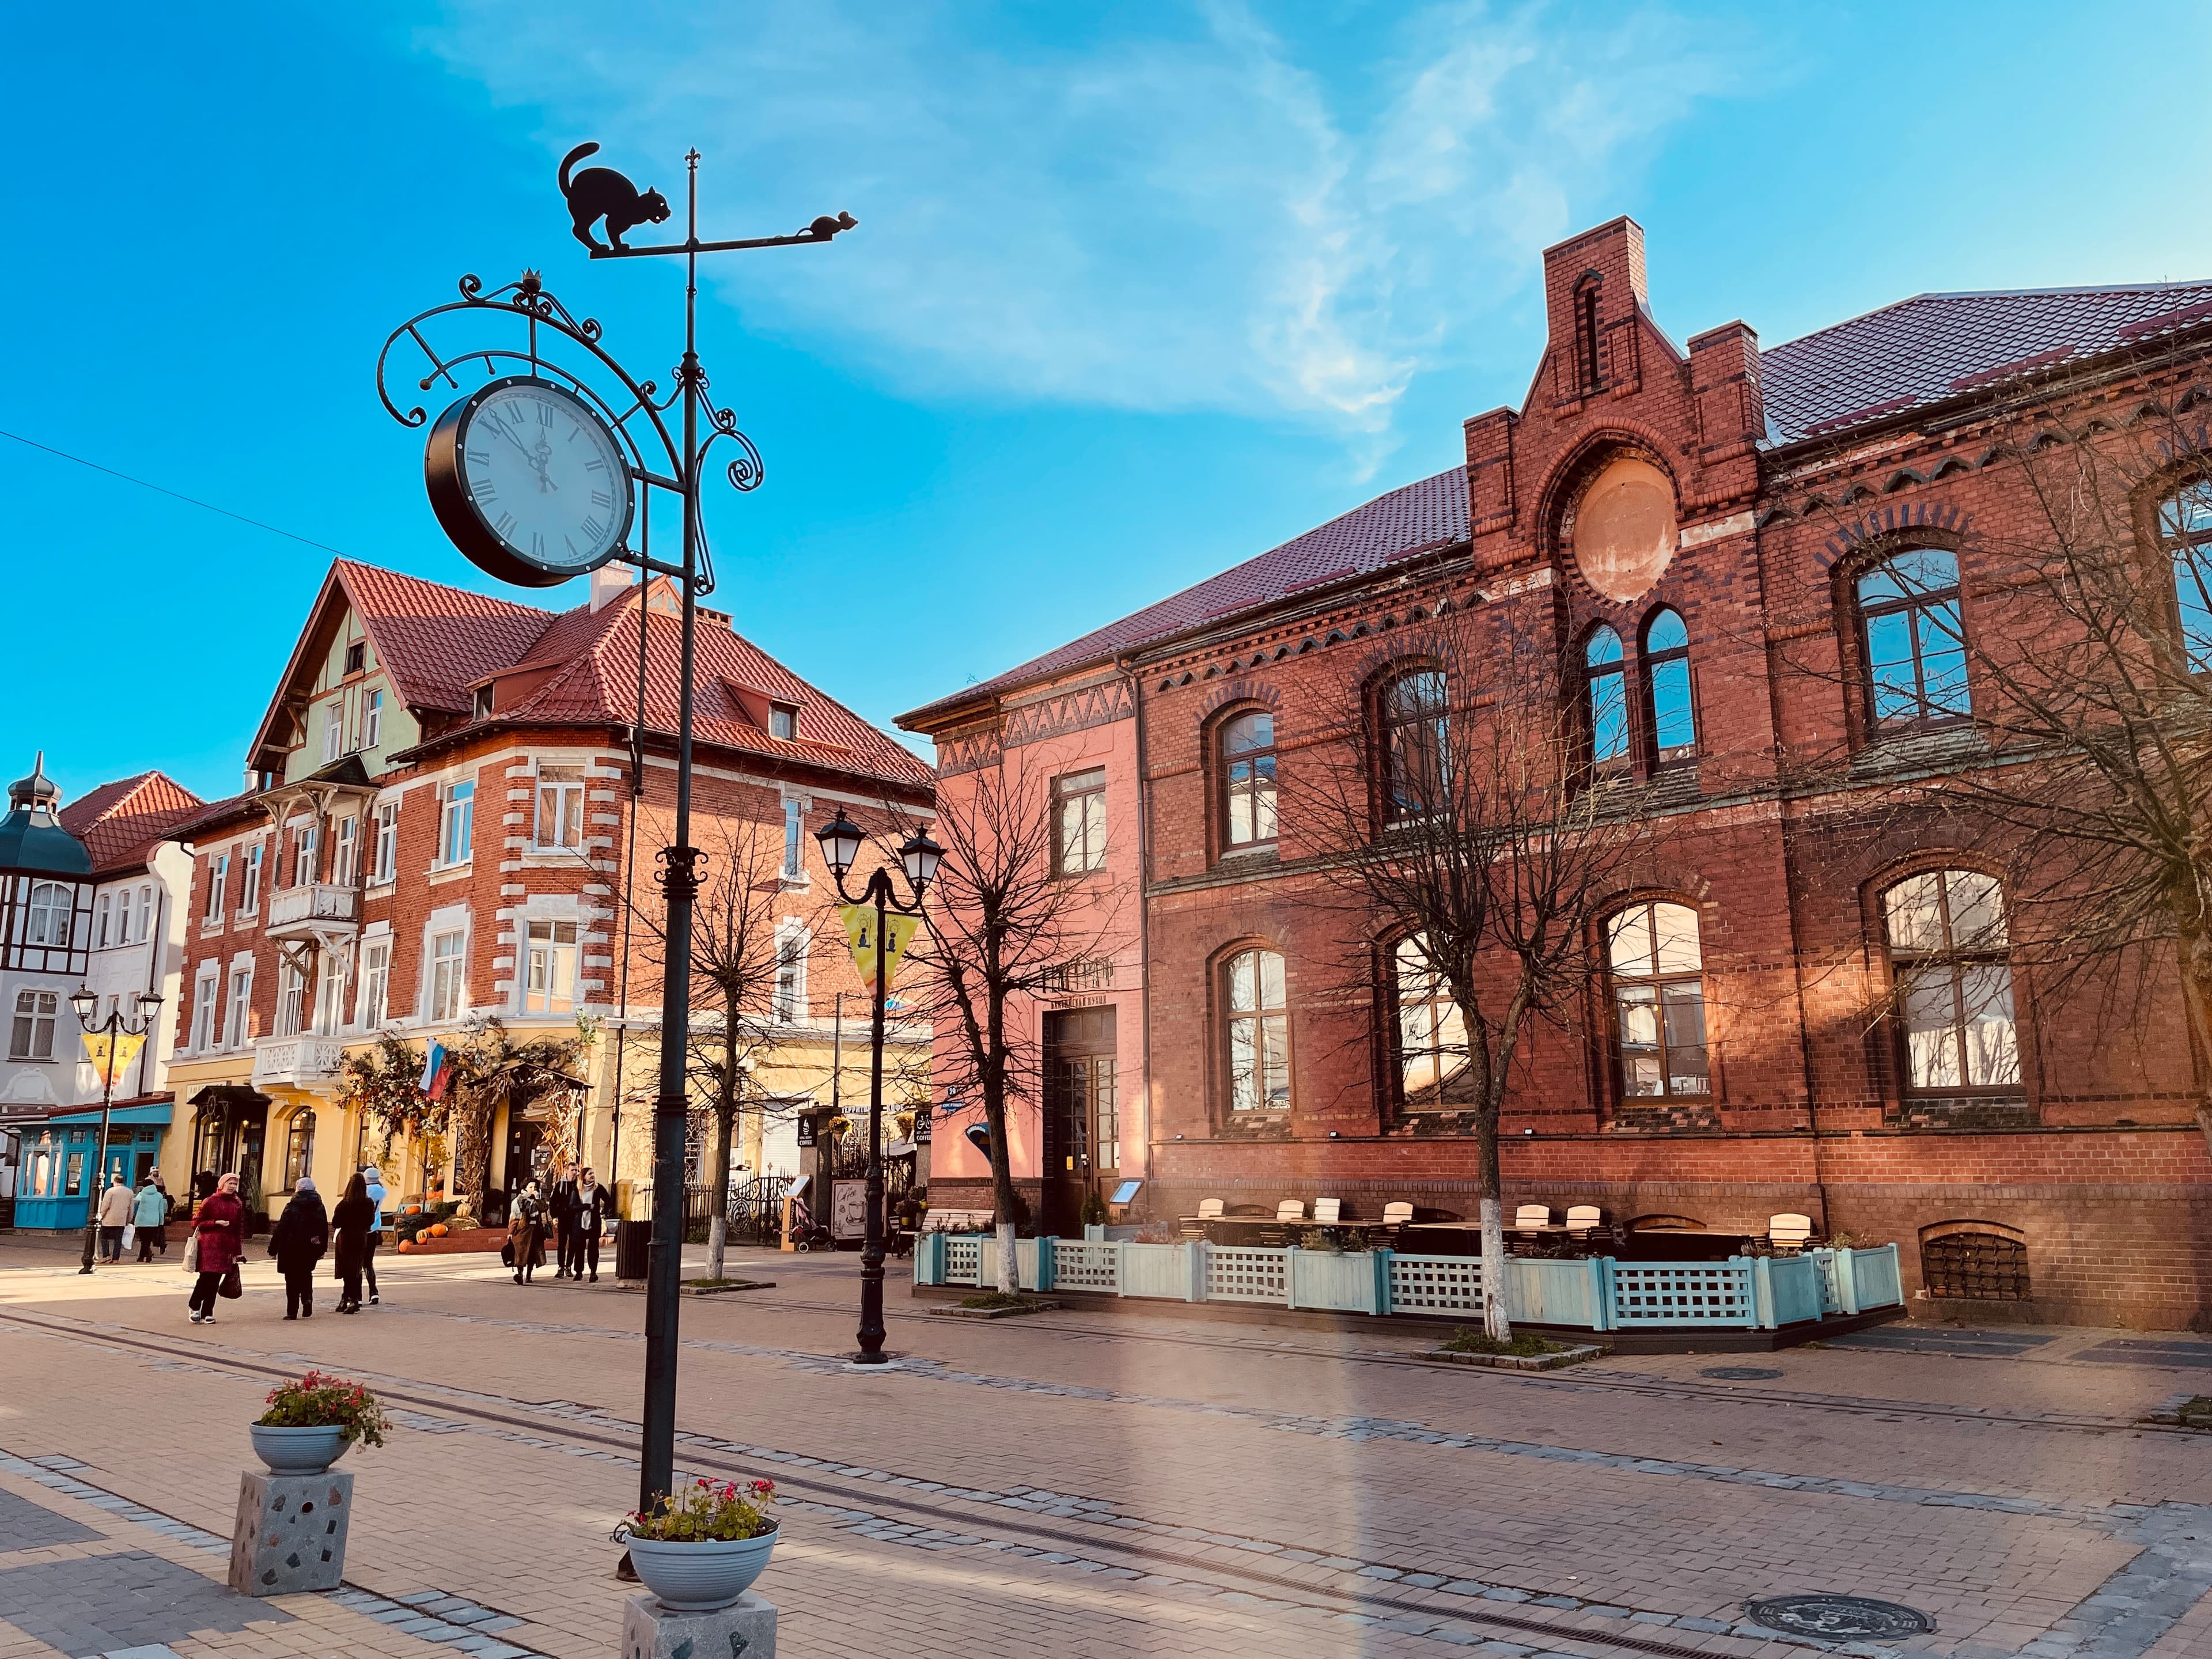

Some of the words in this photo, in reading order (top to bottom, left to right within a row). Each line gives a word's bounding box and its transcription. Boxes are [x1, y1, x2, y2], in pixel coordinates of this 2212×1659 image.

[504, 400, 525, 424] XI
[536, 402, 554, 429] XII
[467, 447, 490, 467] IX
[584, 459, 604, 472] II
[591, 489, 611, 510] III
[837, 1186, 857, 1202] Coffee
